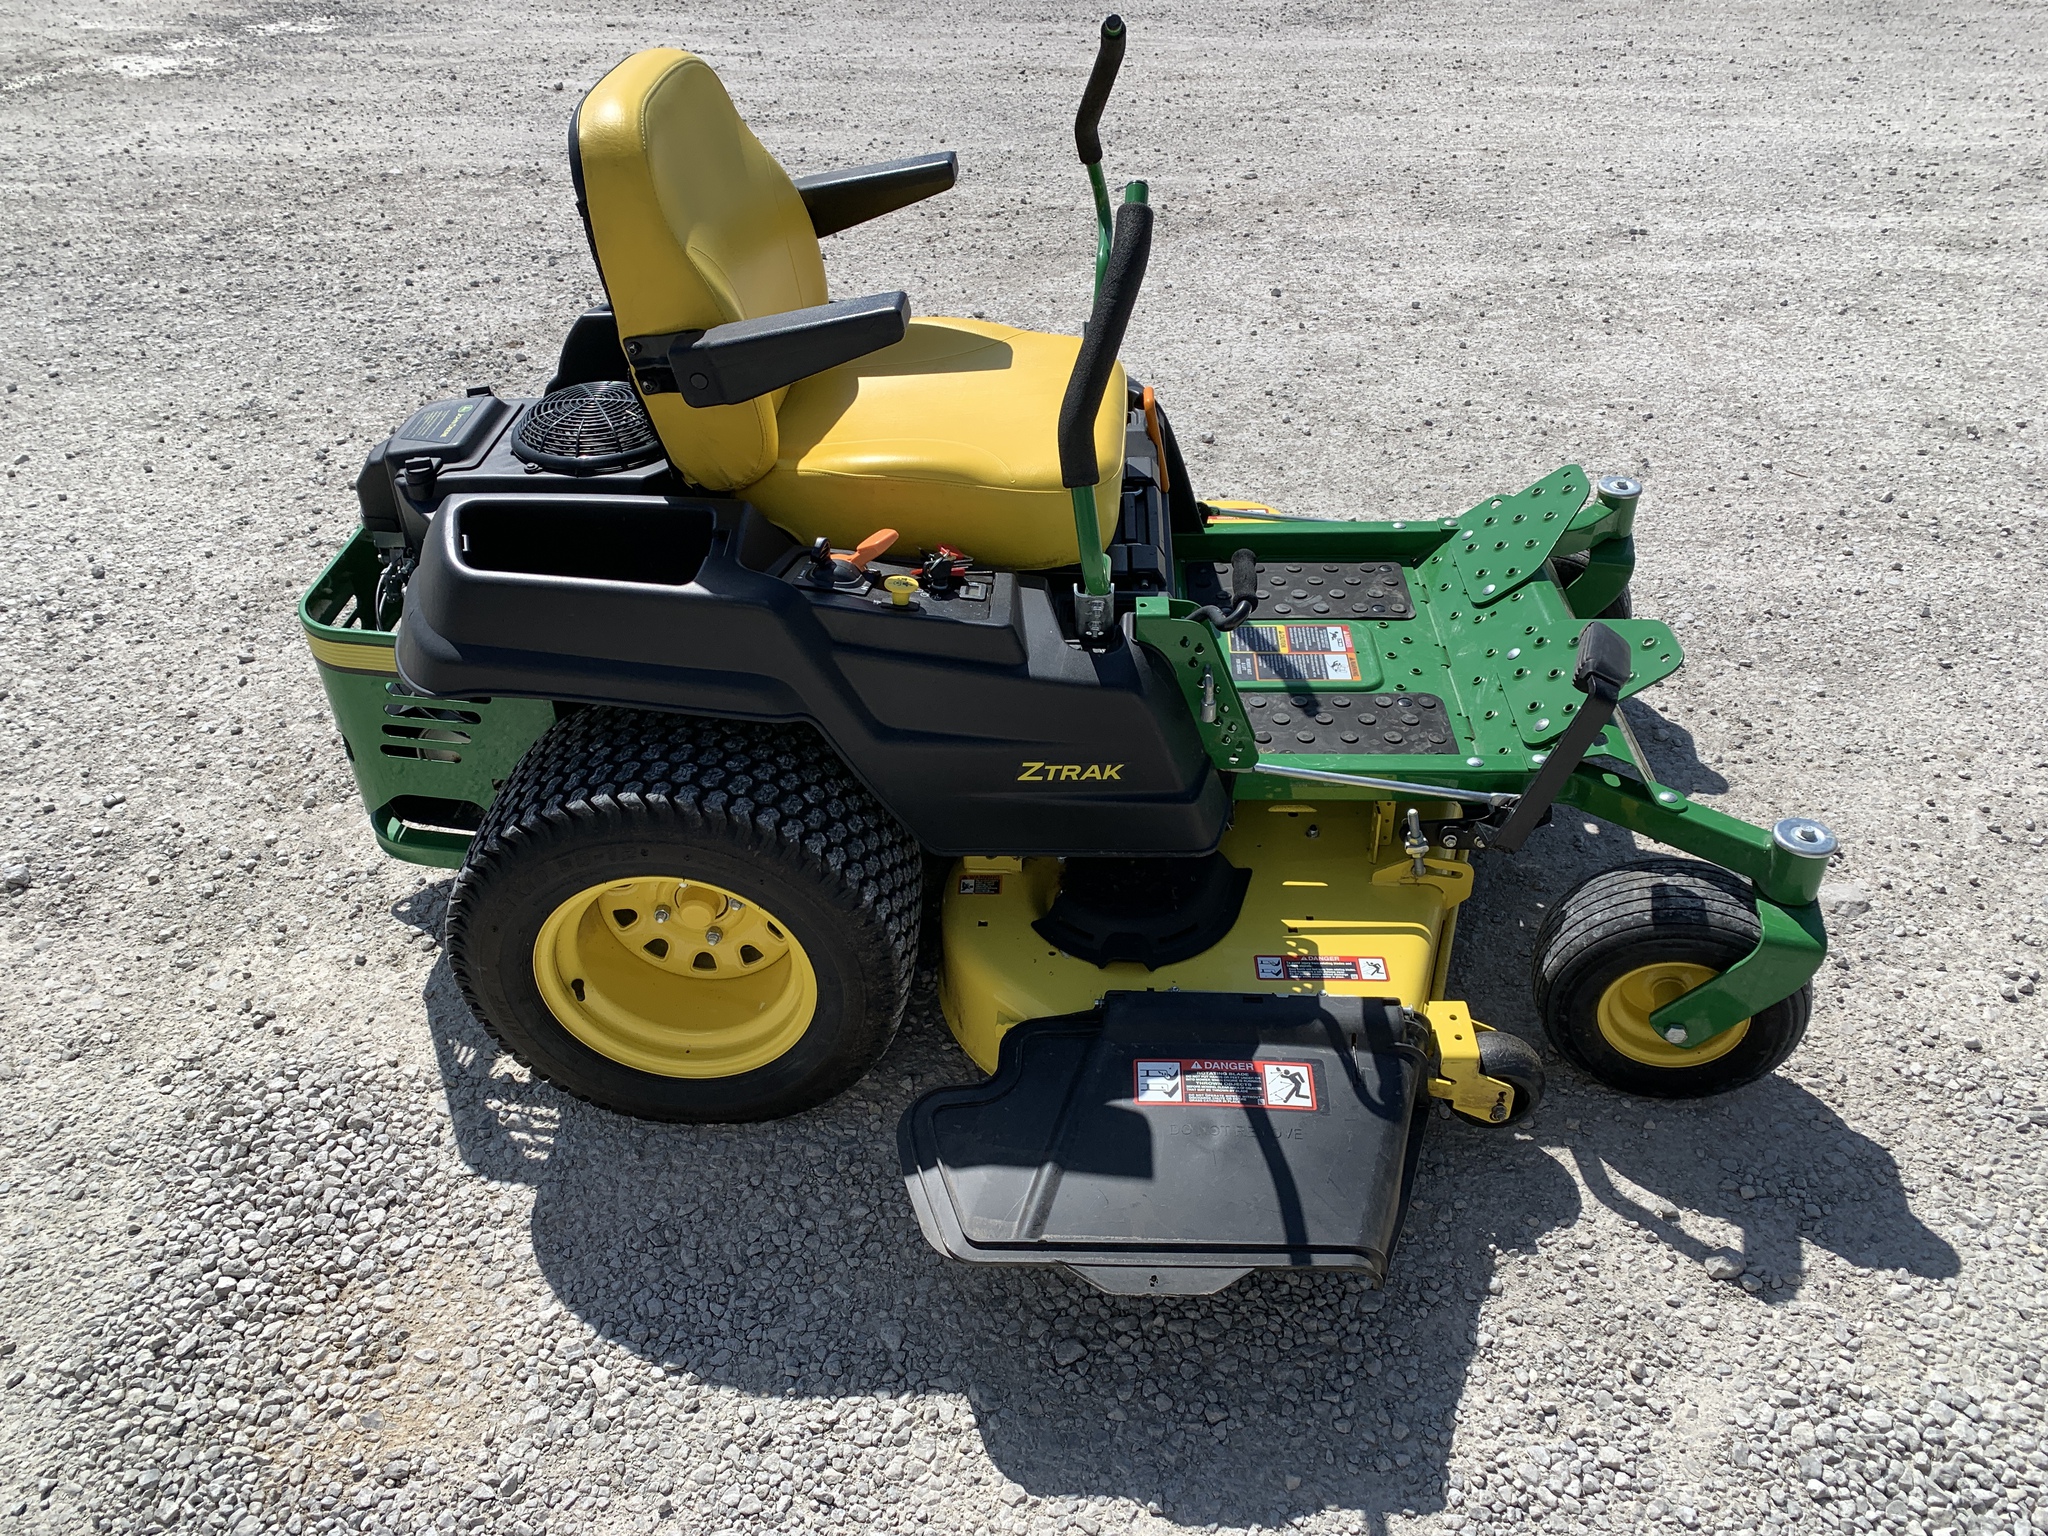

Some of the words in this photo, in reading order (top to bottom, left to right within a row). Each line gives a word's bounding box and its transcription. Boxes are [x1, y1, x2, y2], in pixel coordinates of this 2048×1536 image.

[1017, 762, 1124, 781] ZTRAK
[1204, 1061, 1254, 1070] DANGER
[1170, 1124, 1192, 1136] DO
